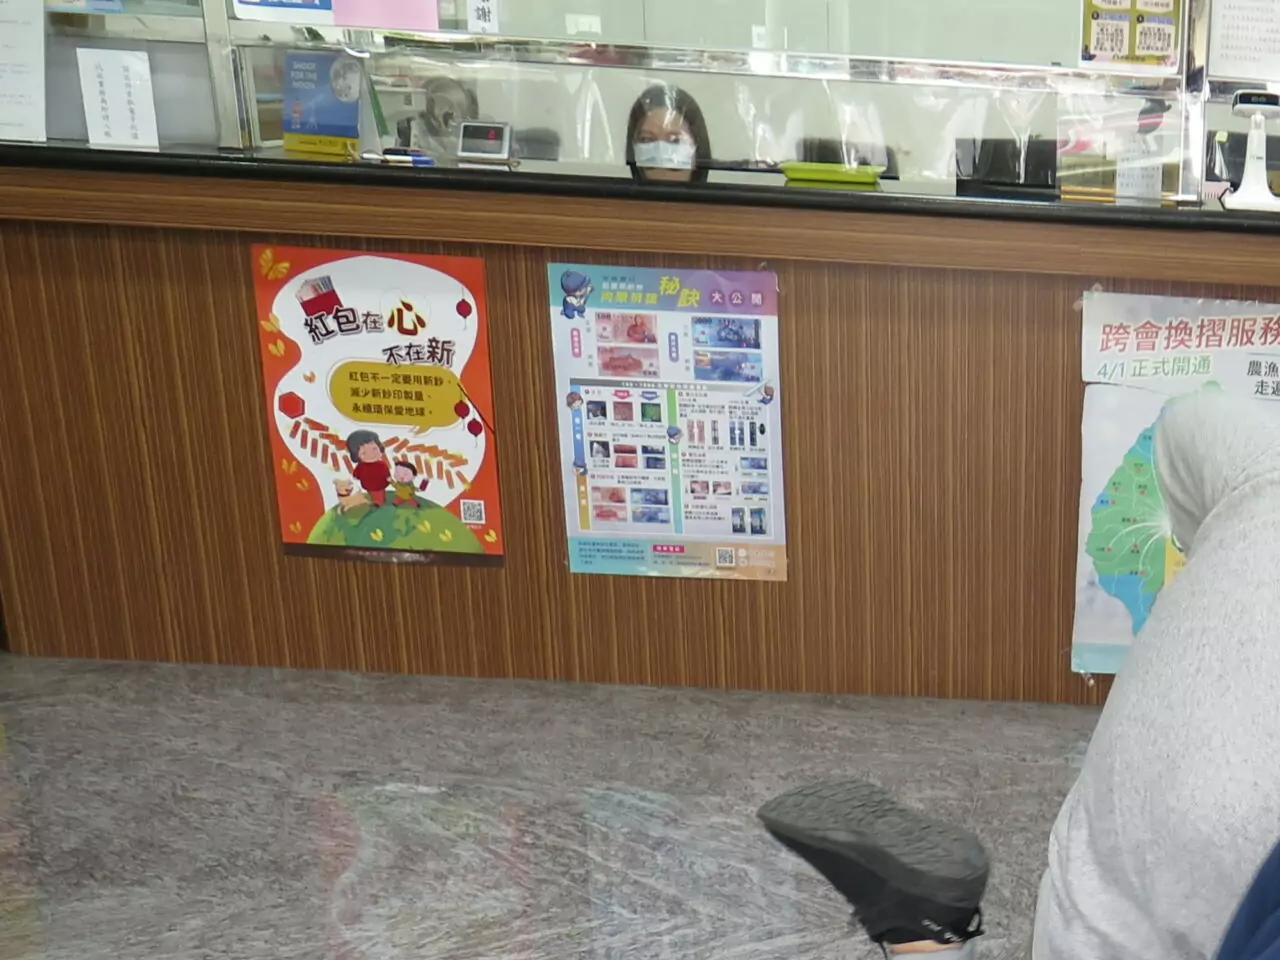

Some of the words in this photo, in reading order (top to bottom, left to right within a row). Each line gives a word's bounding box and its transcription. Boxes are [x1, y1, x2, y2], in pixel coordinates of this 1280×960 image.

[304, 300, 426, 342] 紅包在心
[382, 337, 453, 365] 不在新
[1097, 362, 1126, 380] 4/1
[1131, 355, 1212, 378] 正式開通
